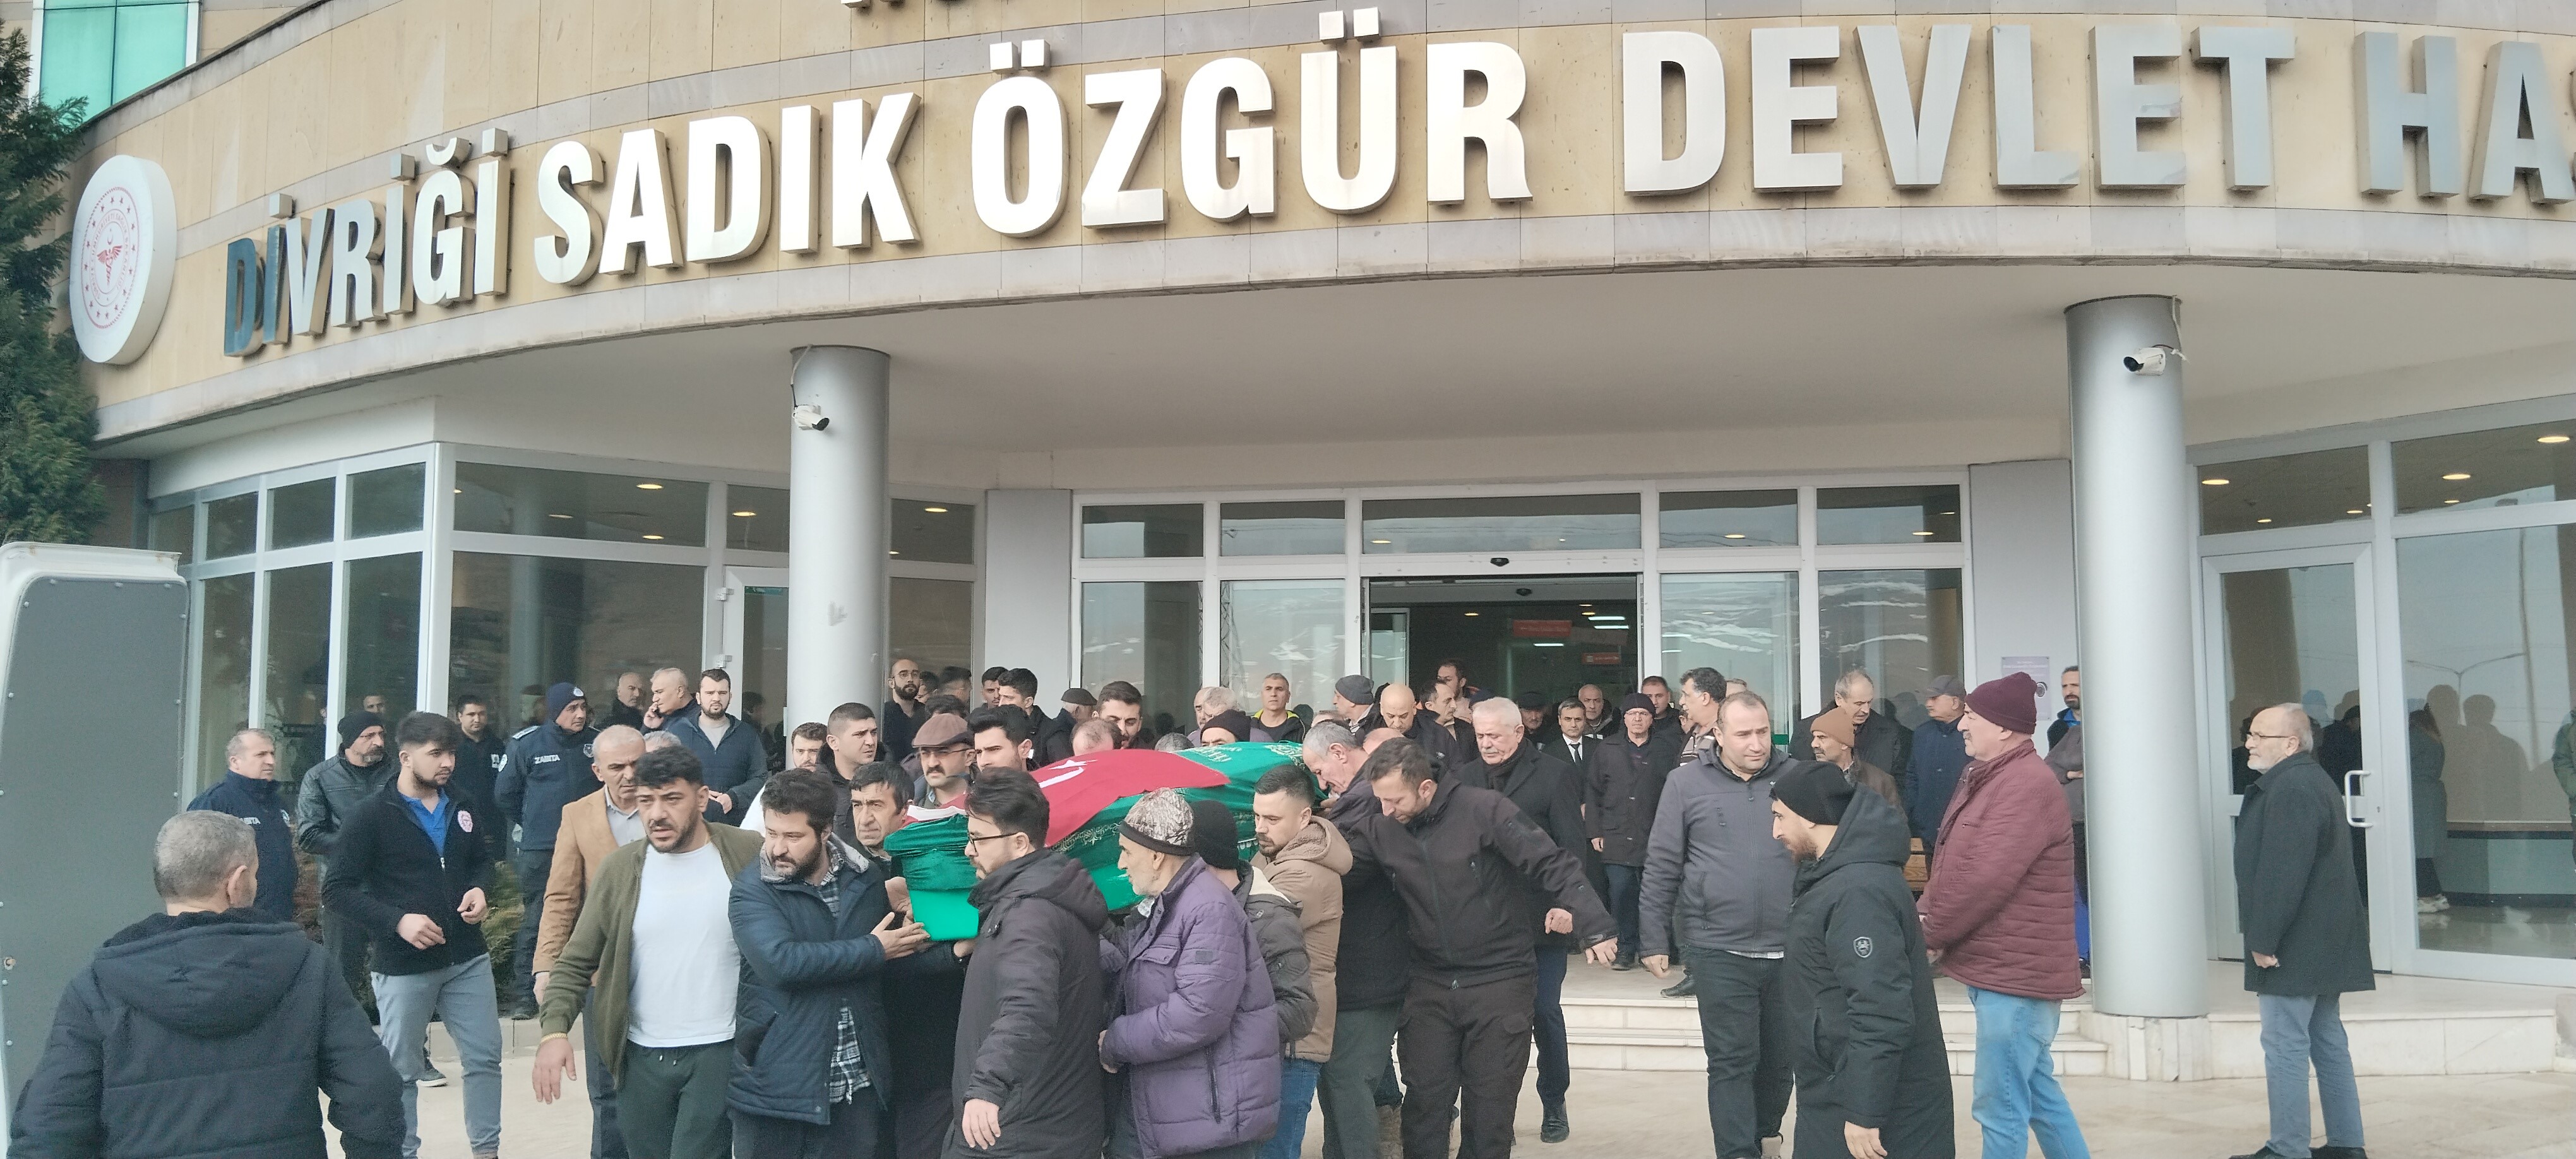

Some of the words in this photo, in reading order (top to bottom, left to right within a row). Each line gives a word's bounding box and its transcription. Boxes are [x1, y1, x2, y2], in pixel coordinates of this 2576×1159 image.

[224, 128, 508, 357] DİVRİĞİ
[534, 92, 921, 285] SADIK
[971, 7, 1533, 238] ÖZGÜR
[1623, 24, 2295, 195] DEVLET
[2354, 32, 2576, 205] HA
